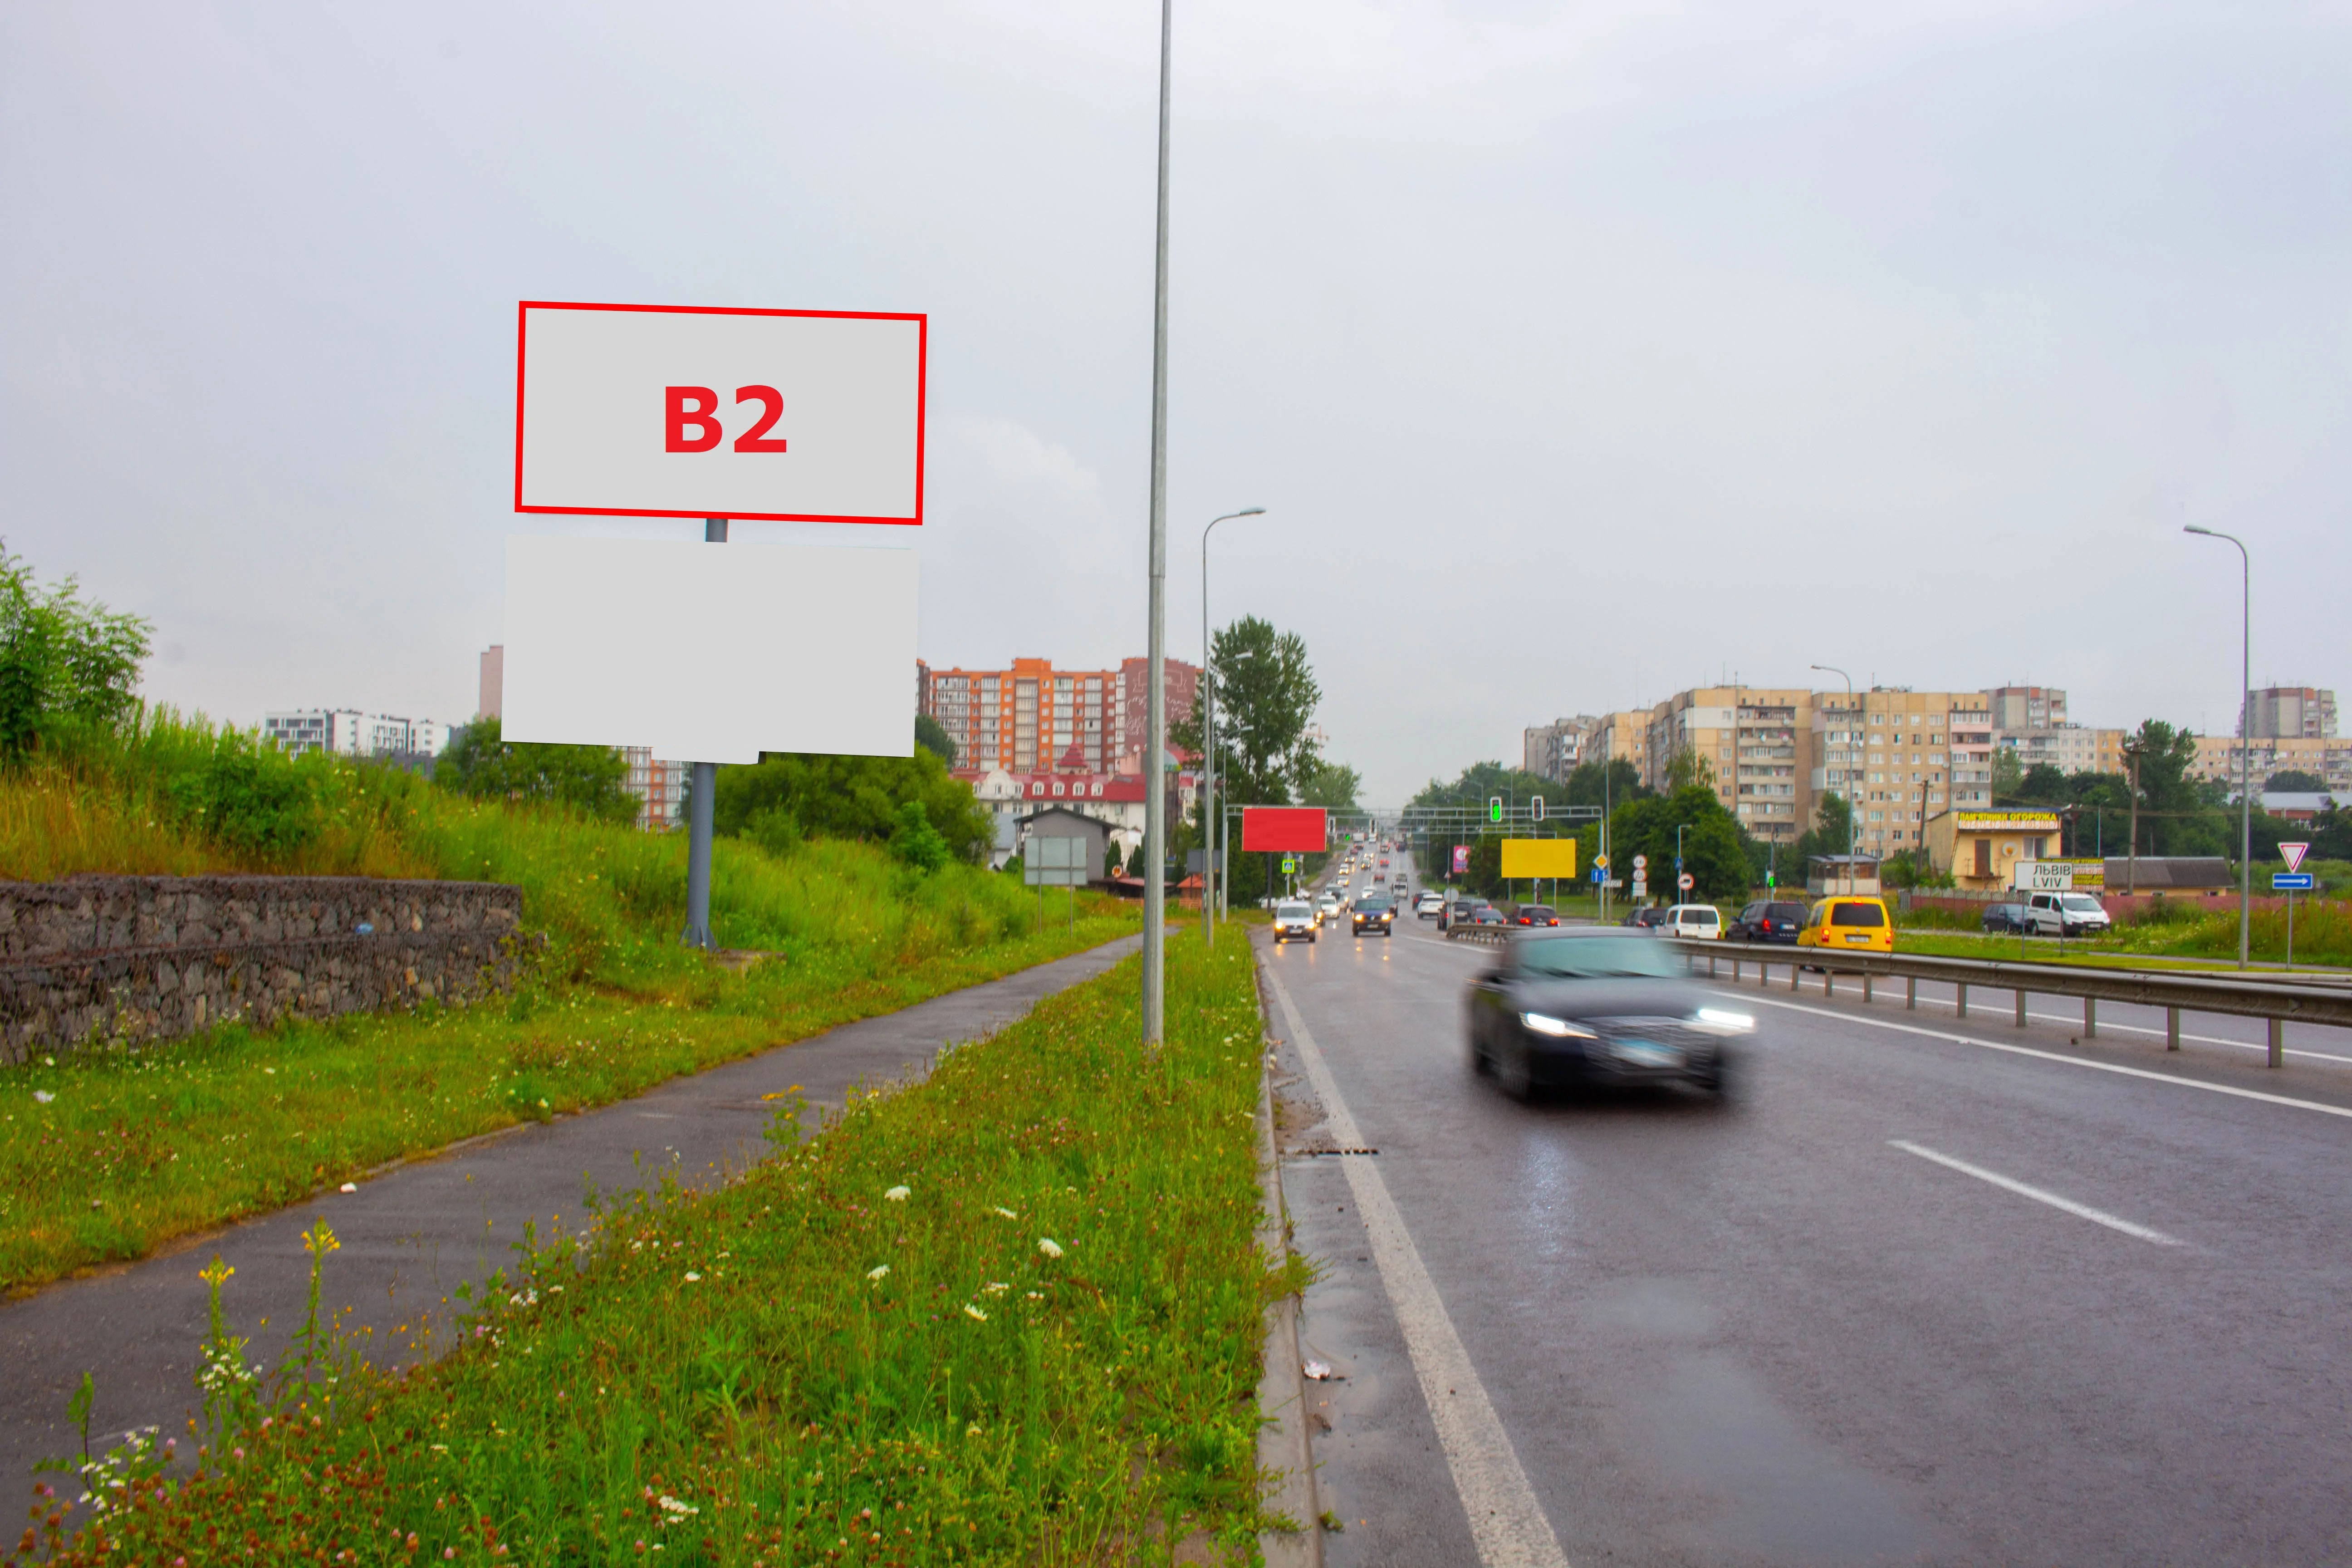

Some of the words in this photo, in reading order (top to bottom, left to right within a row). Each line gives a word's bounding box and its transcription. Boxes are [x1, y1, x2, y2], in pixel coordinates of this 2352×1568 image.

[2009, 812, 2058, 821] ОГОРОЖА
[2033, 865, 2071, 876] ЛЬВІВ
[2033, 877, 2062, 888] LVIV
